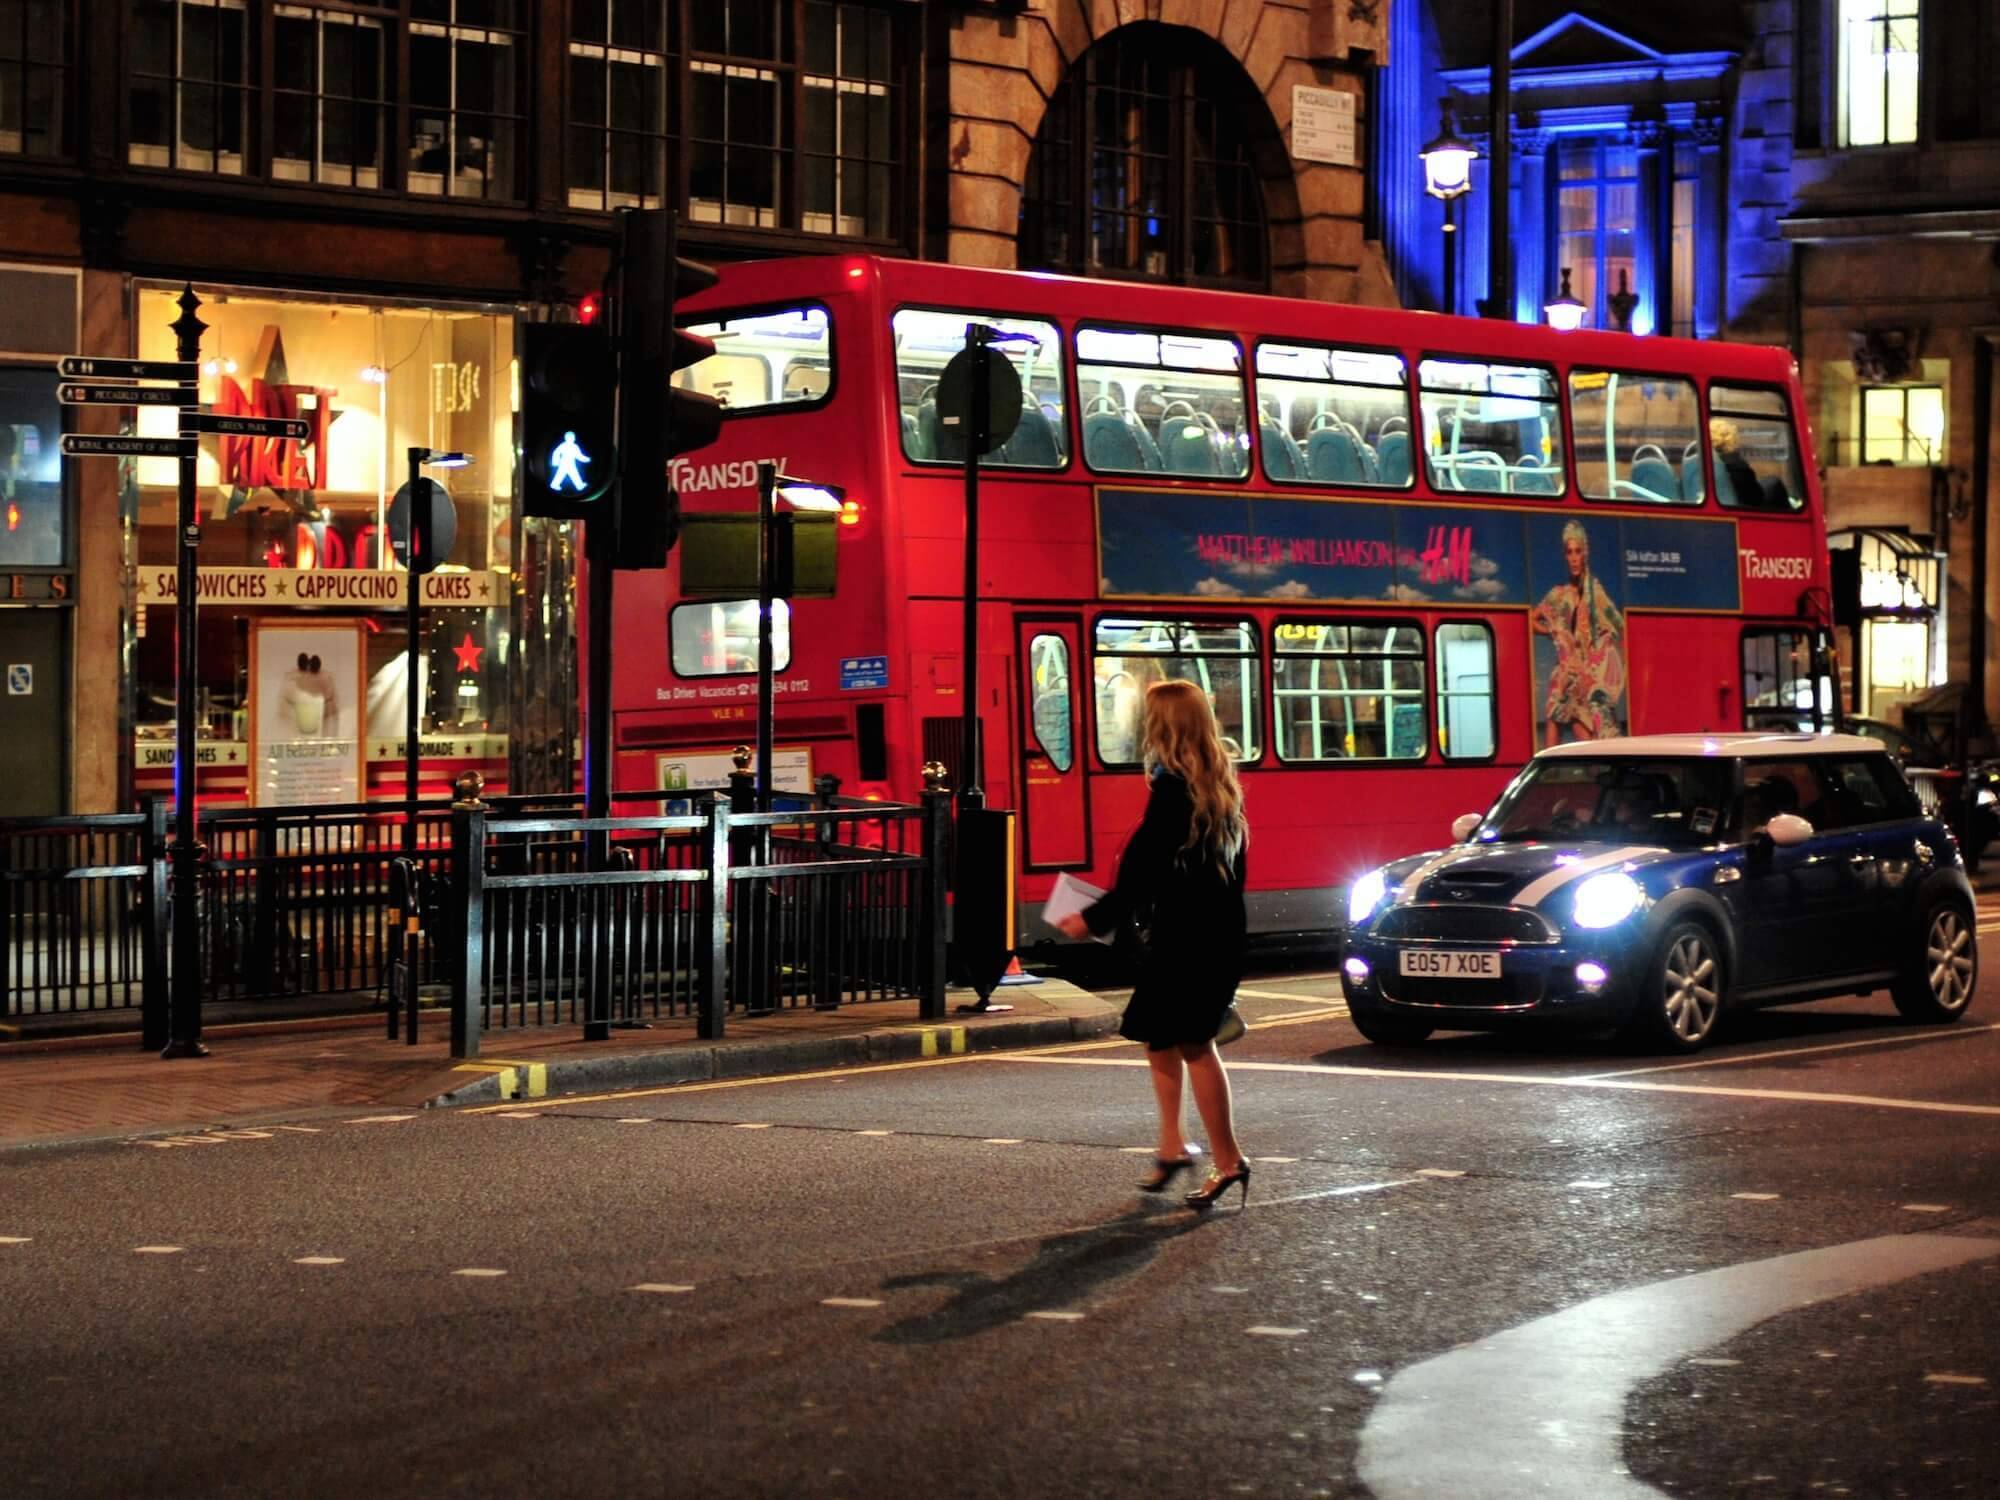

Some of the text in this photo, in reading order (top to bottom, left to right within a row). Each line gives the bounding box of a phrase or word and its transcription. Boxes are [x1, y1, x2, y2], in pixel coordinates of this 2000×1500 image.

[94, 389, 171, 401] PICCADILLY CIRCUS
[217, 420, 267, 432] GREEN PARK
[78, 440, 103, 451] ROYAL
[106, 441, 143, 452] ACADEMY
[1197, 534, 1283, 564] MATTHEW
[1290, 538, 1394, 568] WILLIAMSON
[1739, 549, 1812, 579] TRANSDEV
[296, 575, 398, 599] CAPPUCCINO
[426, 577, 471, 599] CAKES
[657, 687, 671, 700] Bus
[673, 686, 697, 699] Driver
[699, 683, 737, 698] Vacancies
[712, 708, 731, 719] VLE
[1457, 954, 1493, 974] XOE
